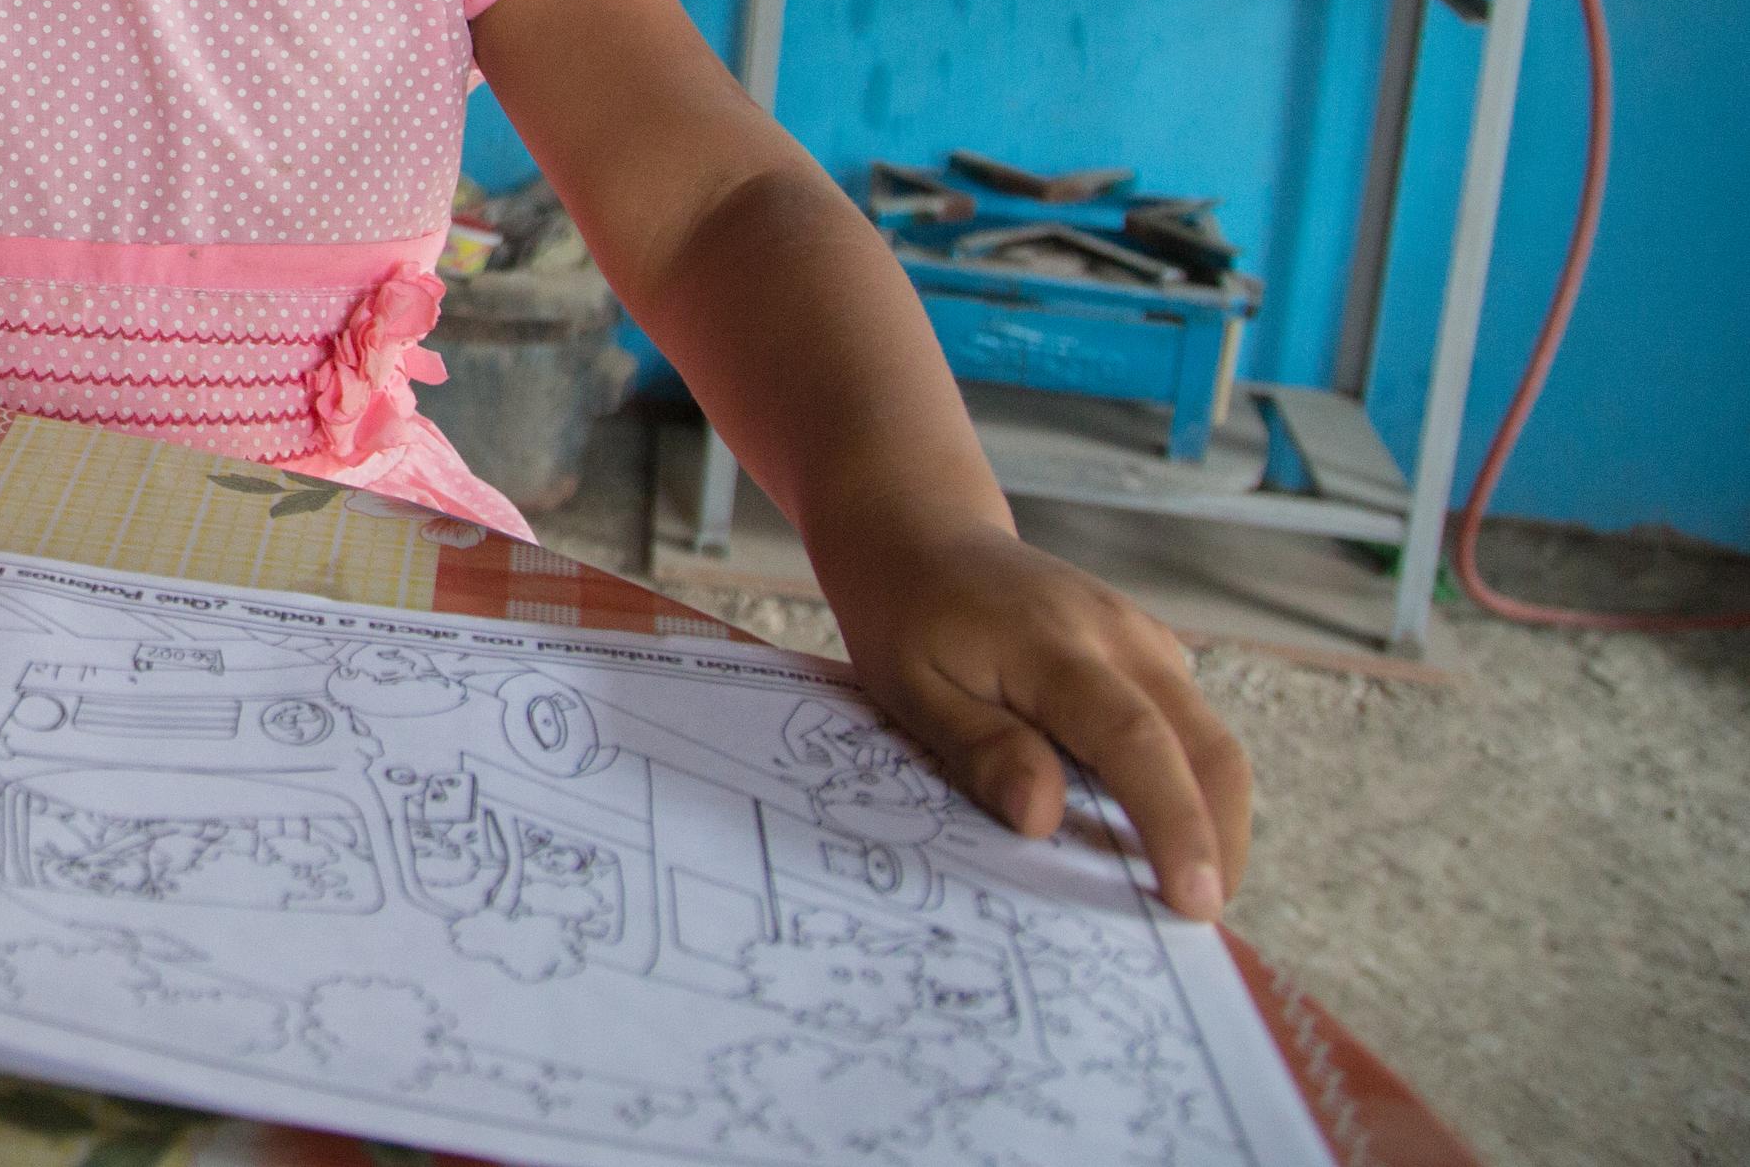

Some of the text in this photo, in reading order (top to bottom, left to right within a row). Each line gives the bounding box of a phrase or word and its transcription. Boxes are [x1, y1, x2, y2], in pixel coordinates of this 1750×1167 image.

[17, 569, 144, 602] Podemos
[155, 593, 228, 612] ¿Qué
[240, 605, 325, 627] todos.
[338, 618, 356, 629] a
[368, 621, 460, 642] afecta
[471, 635, 525, 648] nos
[537, 641, 683, 666] ambiental
